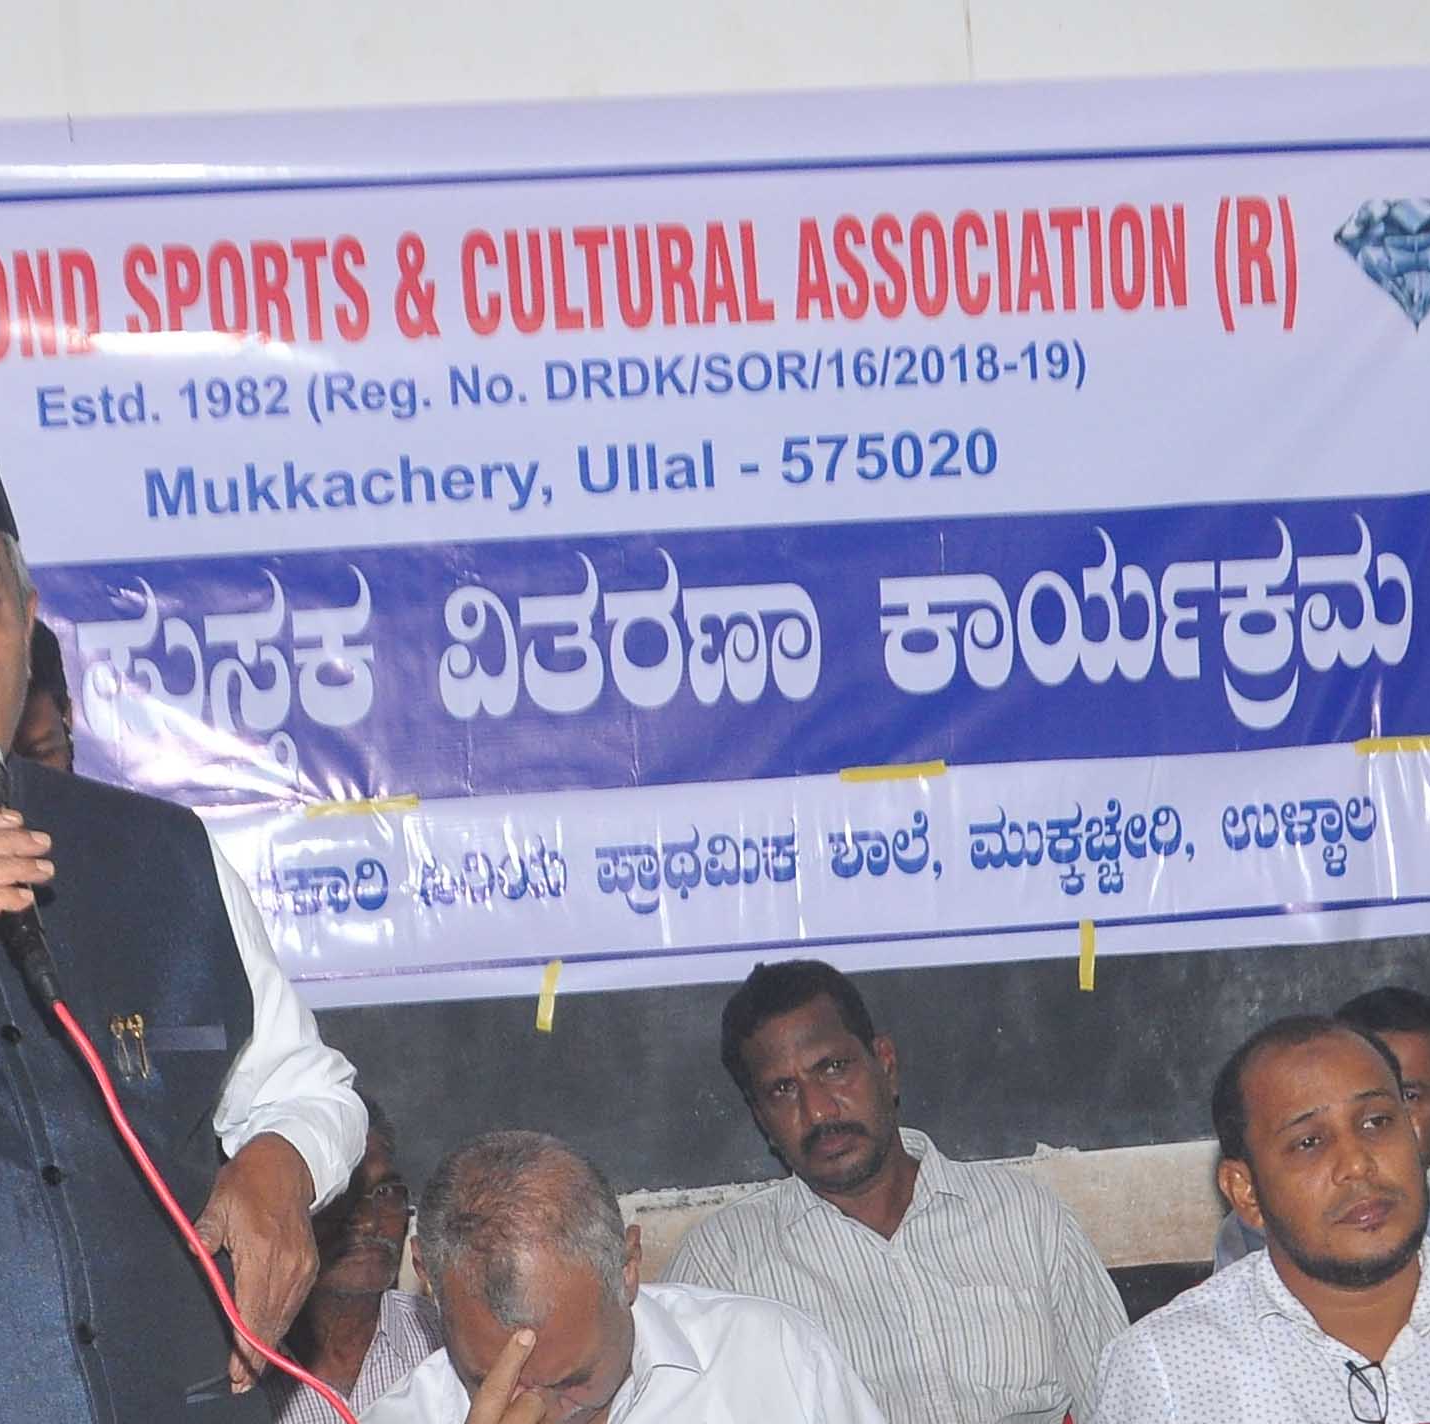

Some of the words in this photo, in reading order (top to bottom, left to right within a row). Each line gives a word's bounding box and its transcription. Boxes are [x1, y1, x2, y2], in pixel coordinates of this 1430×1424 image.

[121, 232, 371, 348] SPORTS
[394, 230, 442, 340] &
[459, 217, 775, 337] CULTURAL
[794, 201, 1188, 321] ASSOCIATION
[1213, 194, 1299, 334] (R)
[35, 380, 161, 428] Estd.
[178, 372, 291, 421] 1982
[306, 370, 432, 425] (Reg.
[448, 362, 528, 406] No.
[544, 337, 1087, 402] DRDK/SOR/16/2018-19)
[143, 452, 553, 518] Mukkachery,
[576, 439, 716, 494] Ullal
[779, 426, 999, 484] 575020
[437, 546, 823, 721] ವಿತರಣಾ
[877, 511, 1415, 731] ಕಾರ್ಯಕ್ರಮ
[594, 823, 800, 916] ಪ್ರಾಥಮಿಕ
[828, 808, 942, 882] ಶಾಲೆ,
